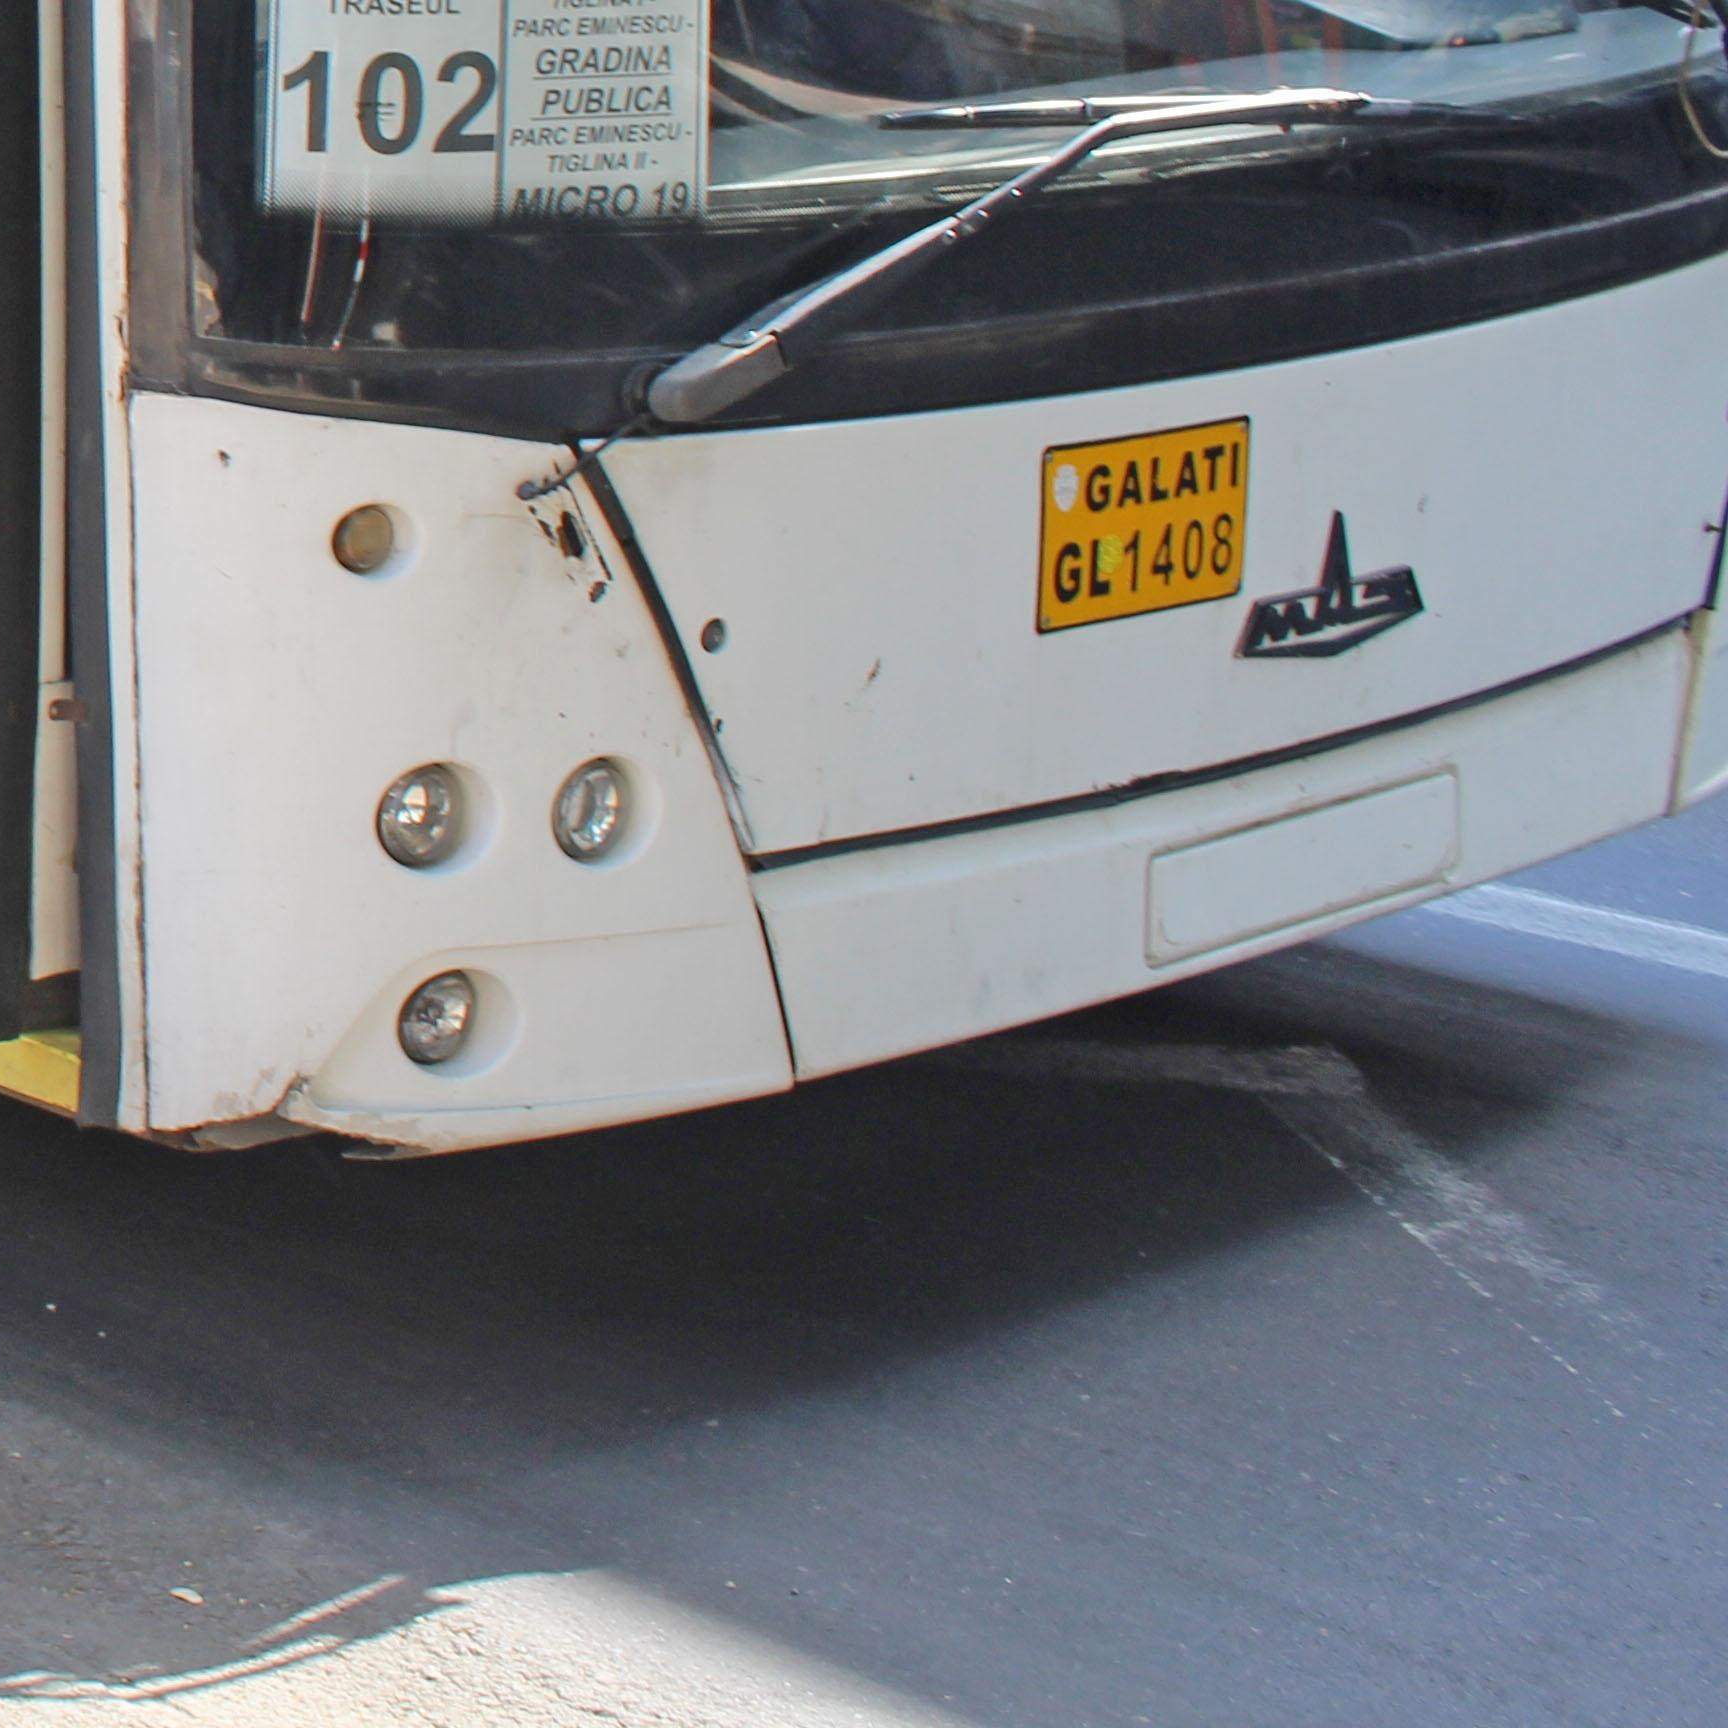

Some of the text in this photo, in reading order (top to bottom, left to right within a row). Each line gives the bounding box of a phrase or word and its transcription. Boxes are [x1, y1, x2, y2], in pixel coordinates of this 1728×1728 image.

[512, 18, 571, 38] PARC
[575, 15, 683, 37] EMINESCU
[535, 44, 672, 75] GRADINA
[281, 50, 498, 156] 102
[540, 85, 672, 115] PUBLICA
[509, 127, 569, 147] PARC
[573, 123, 681, 145] EMINESCU
[548, 151, 629, 173] TIGLINA
[512, 181, 689, 218] MICRO 19
[1085, 442, 1241, 513] GALATI
